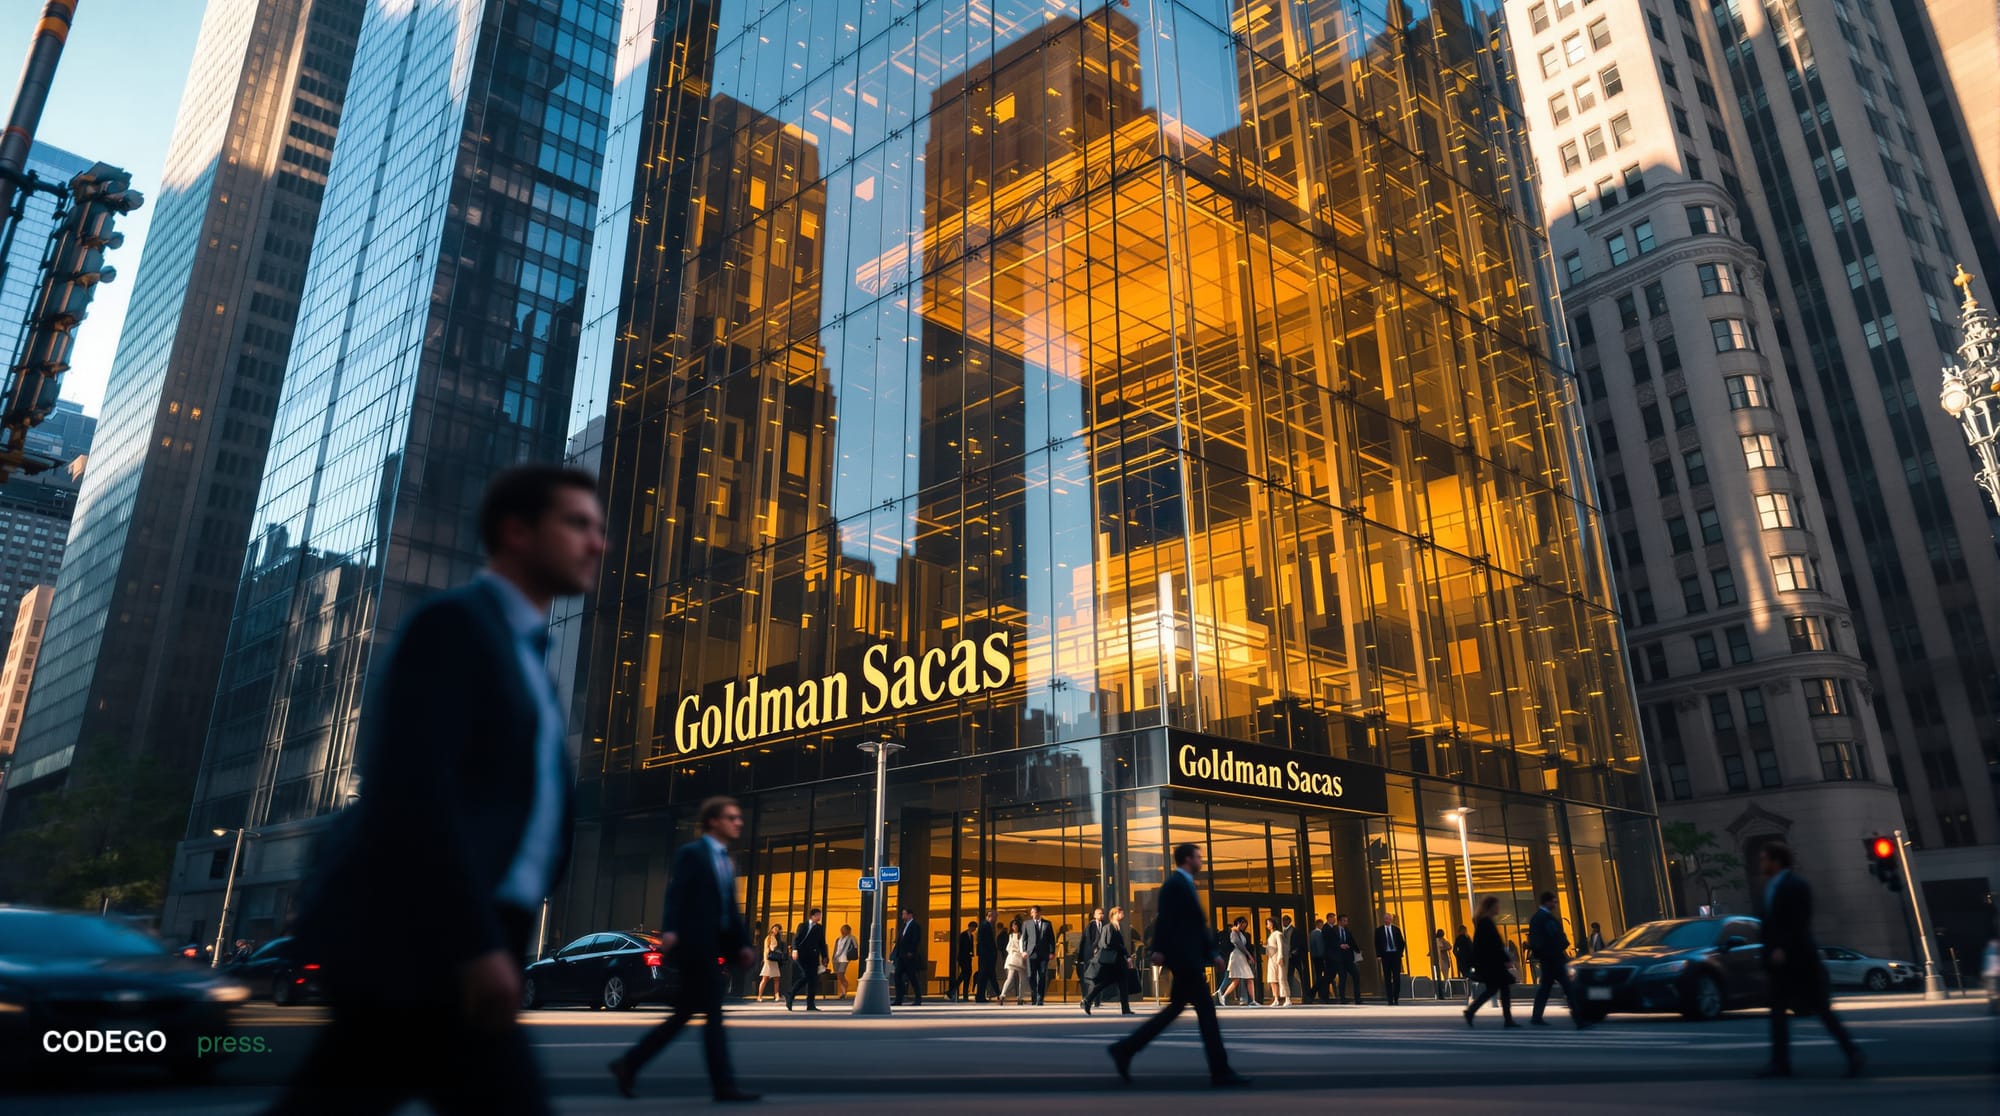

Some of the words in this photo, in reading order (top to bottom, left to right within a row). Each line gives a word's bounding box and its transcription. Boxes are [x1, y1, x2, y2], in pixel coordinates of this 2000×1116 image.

[674, 671, 848, 754] Goldman
[861, 631, 1011, 715] Sacas
[1179, 744, 1282, 789] Goldman
[1287, 760, 1343, 797] Sacas
